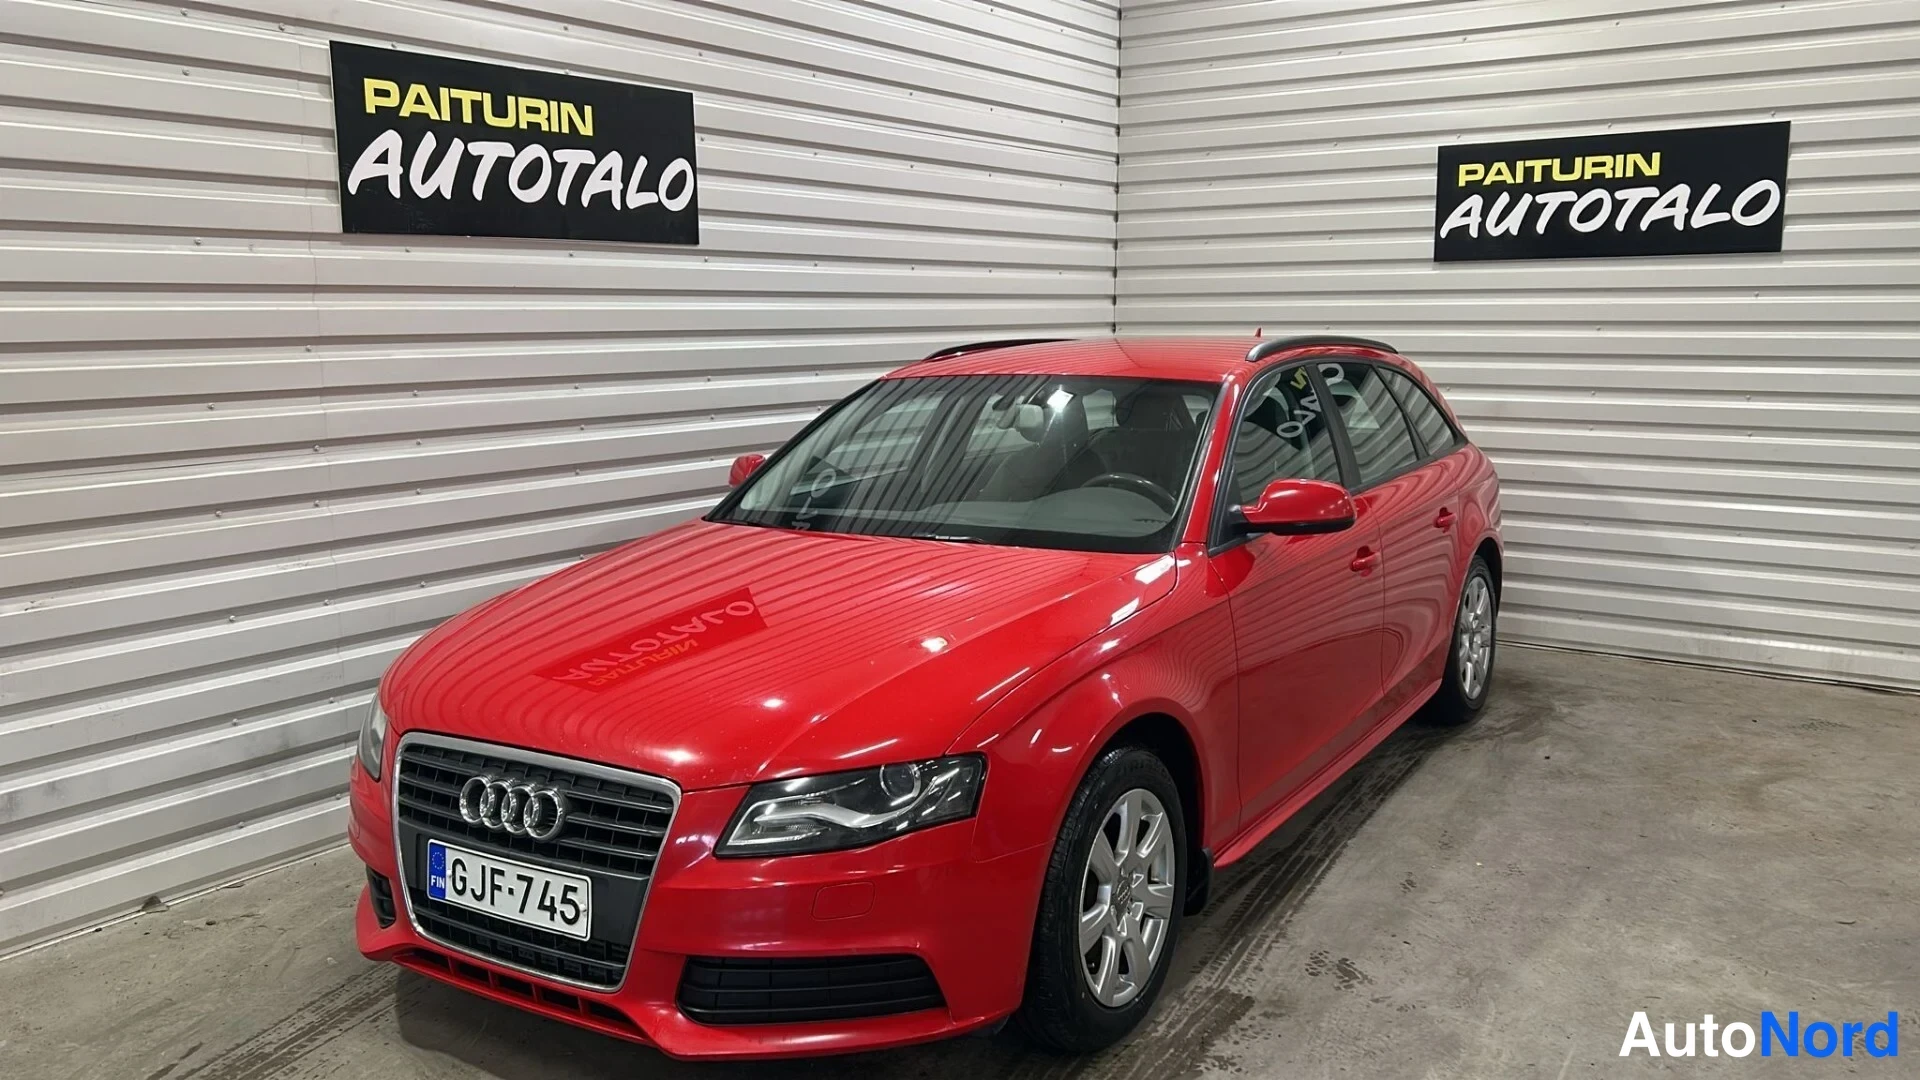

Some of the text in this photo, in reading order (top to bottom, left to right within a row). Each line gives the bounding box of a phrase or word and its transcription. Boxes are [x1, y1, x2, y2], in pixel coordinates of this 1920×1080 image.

[364, 78, 594, 136] PAITURIN
[347, 129, 694, 211] AUTOTALO
[1458, 152, 1661, 187] PAITURIN
[1439, 179, 1780, 239] AUTOTALO
[431, 875, 445, 889] FIN
[451, 858, 581, 925] GJF-745
